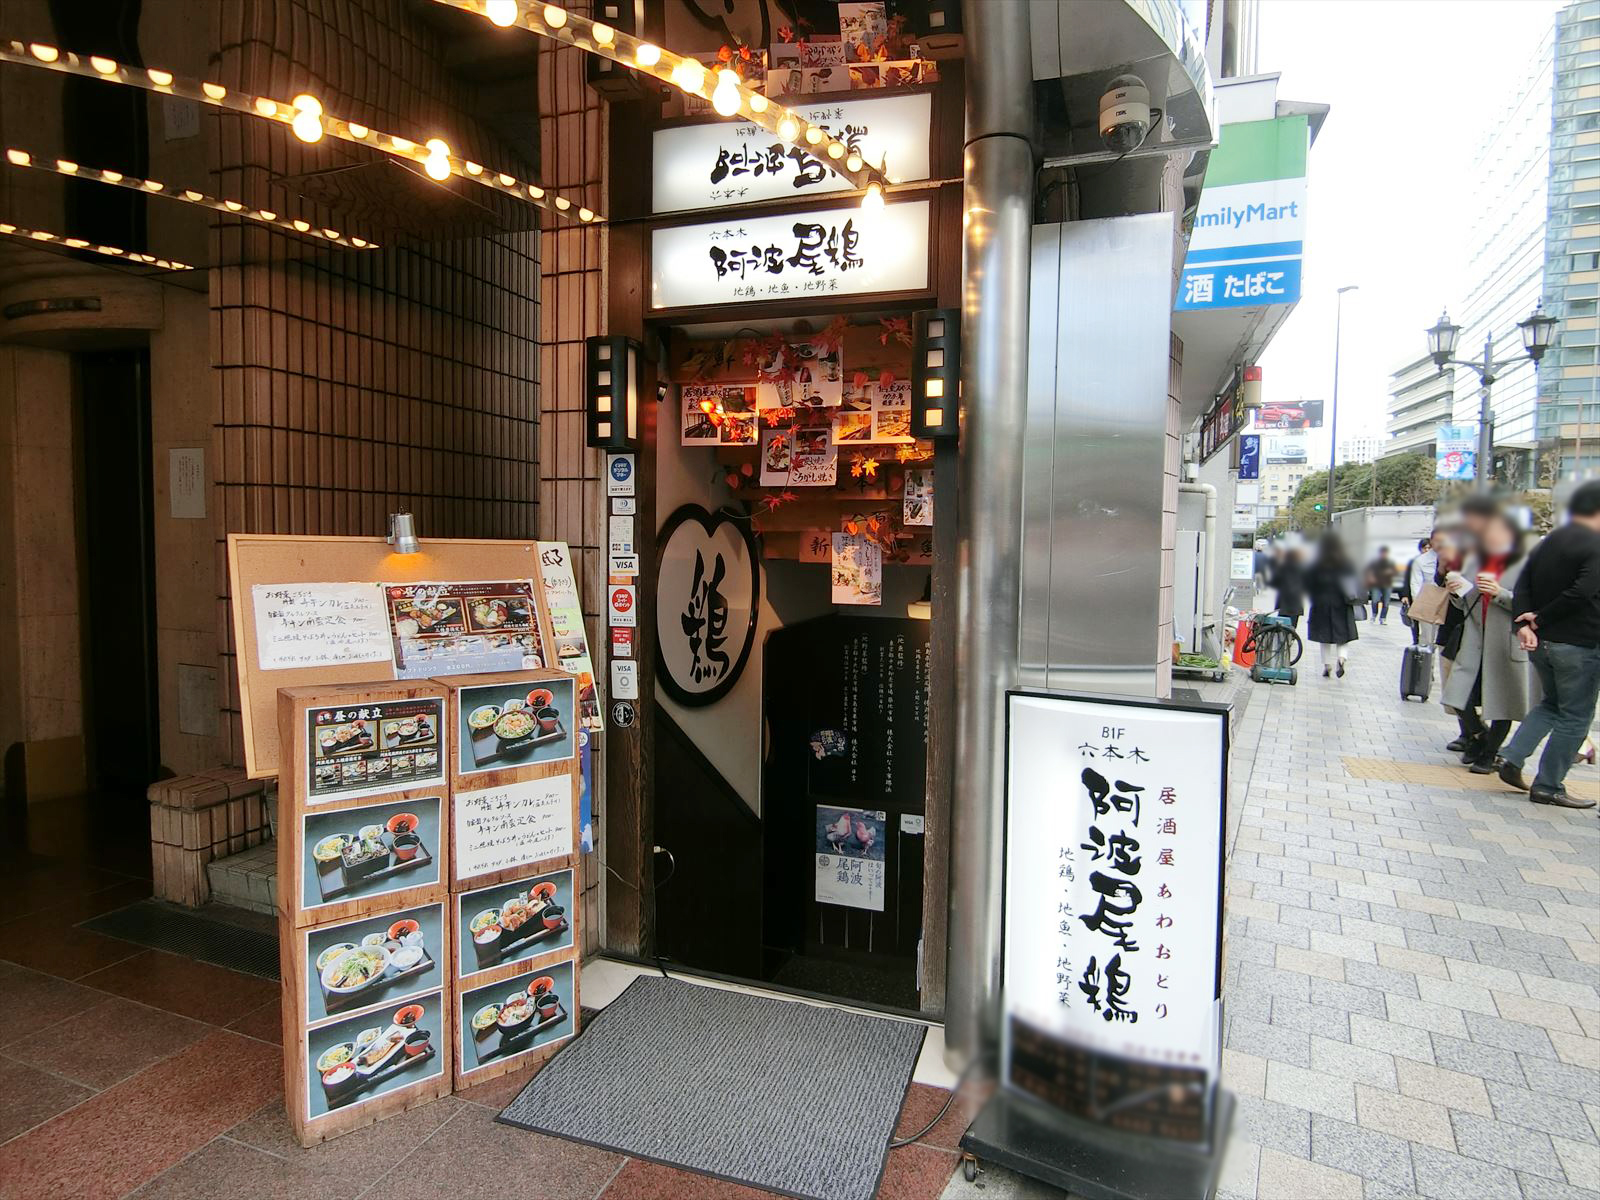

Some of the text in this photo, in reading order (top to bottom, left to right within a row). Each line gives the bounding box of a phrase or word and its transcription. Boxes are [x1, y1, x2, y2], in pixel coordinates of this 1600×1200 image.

[1193, 202, 1298, 228] amilyMart
[709, 228, 748, 240] 六本木
[1185, 271, 1285, 303] 酒 たばこ
[334, 707, 383, 722] 昼の献立
[1102, 726, 1125, 740] B1F
[1078, 742, 1150, 764] 六本木
[1056, 846, 1075, 1008] 地鶏・地魚・地野菜
